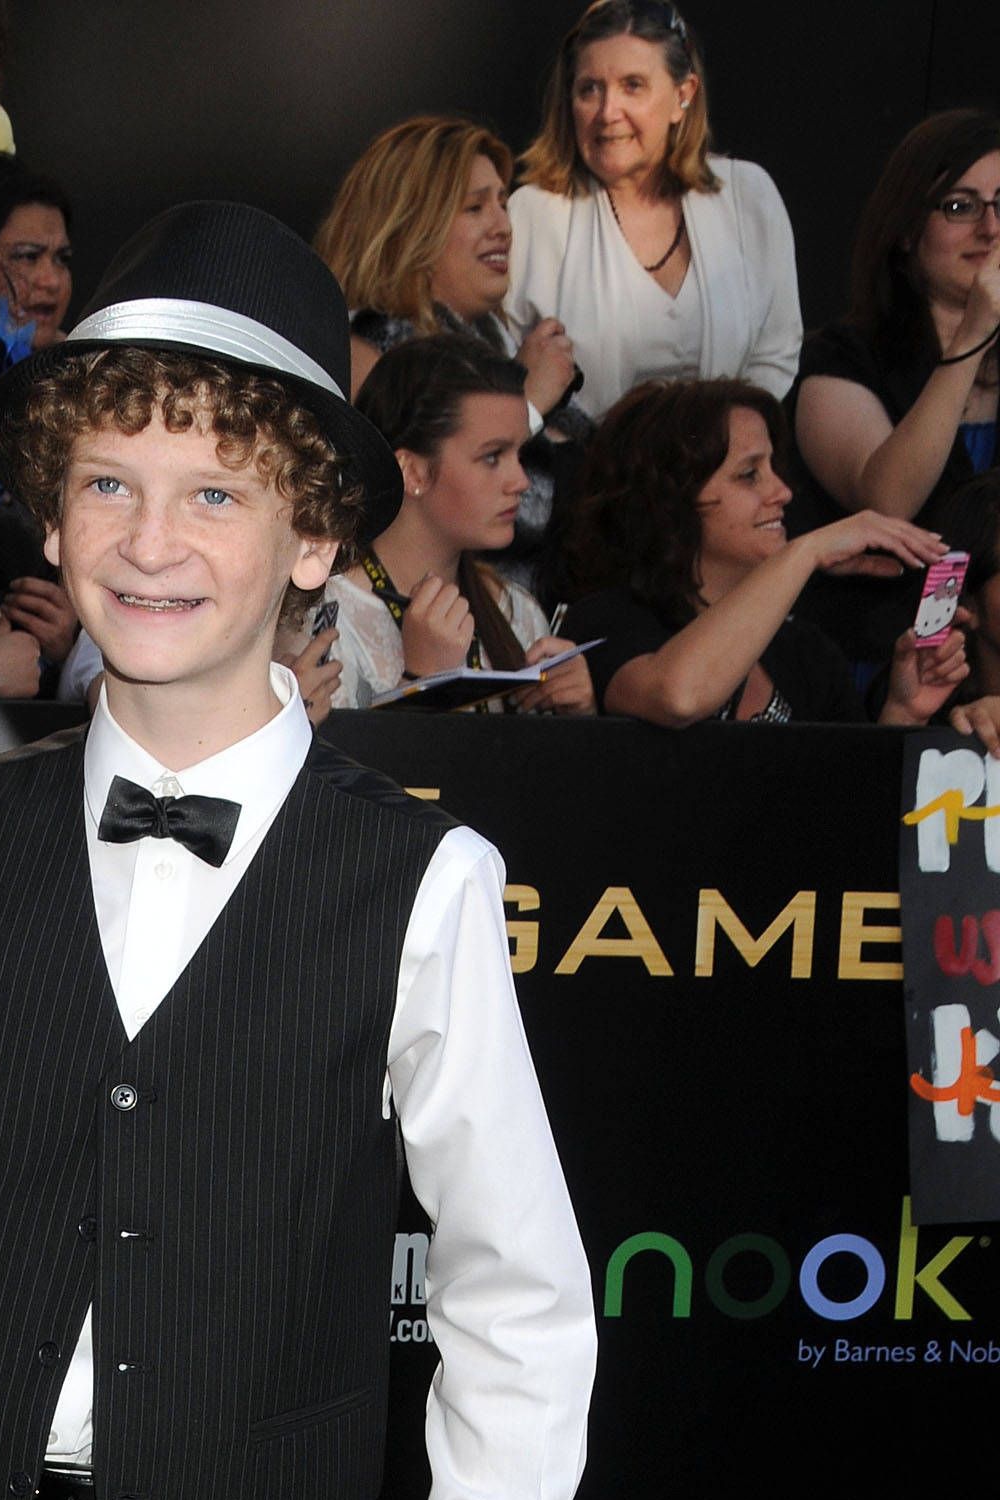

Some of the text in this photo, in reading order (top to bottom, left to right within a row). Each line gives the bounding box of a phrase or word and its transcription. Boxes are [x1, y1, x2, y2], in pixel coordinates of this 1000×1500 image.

[603, 1195, 976, 1321] nook
[798, 1339, 827, 1369] by
[834, 1339, 916, 1363] Barnes
[923, 1340, 943, 1363] &
